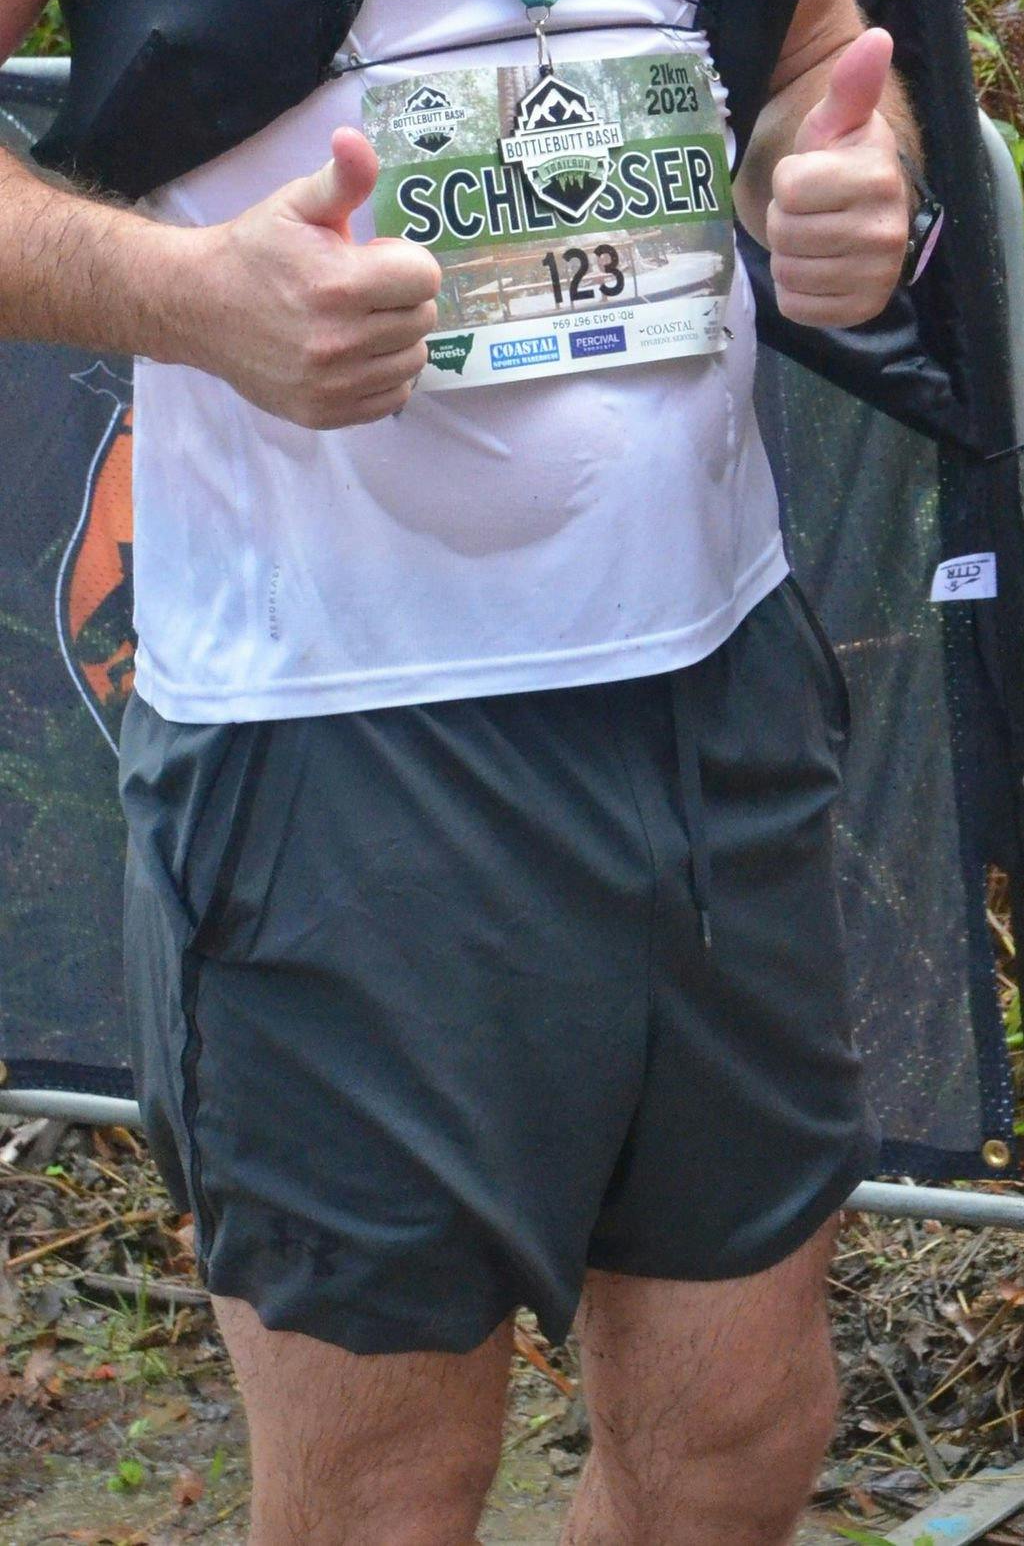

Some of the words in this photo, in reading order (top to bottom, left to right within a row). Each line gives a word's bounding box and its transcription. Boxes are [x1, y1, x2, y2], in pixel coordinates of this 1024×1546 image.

[649, 63, 689, 86] 21km
[645, 86, 698, 115] 2023
[393, 112, 442, 129] BOTTLEBUTT
[445, 110, 465, 120] BASH
[505, 133, 584, 159] BOTTLEBUTT
[586, 127, 620, 147] BASH
[397, 146, 718, 245] SCHLSSER
[542, 244, 625, 304] 123
[553, 318, 571, 330] 694
[574, 316, 590, 327] 967
[594, 313, 615, 324] 0413
[646, 320, 694, 336] COASTAL
[492, 338, 557, 359] COASTAL
[576, 335, 620, 348] PERCIVAL
[430, 348, 466, 360] forests
